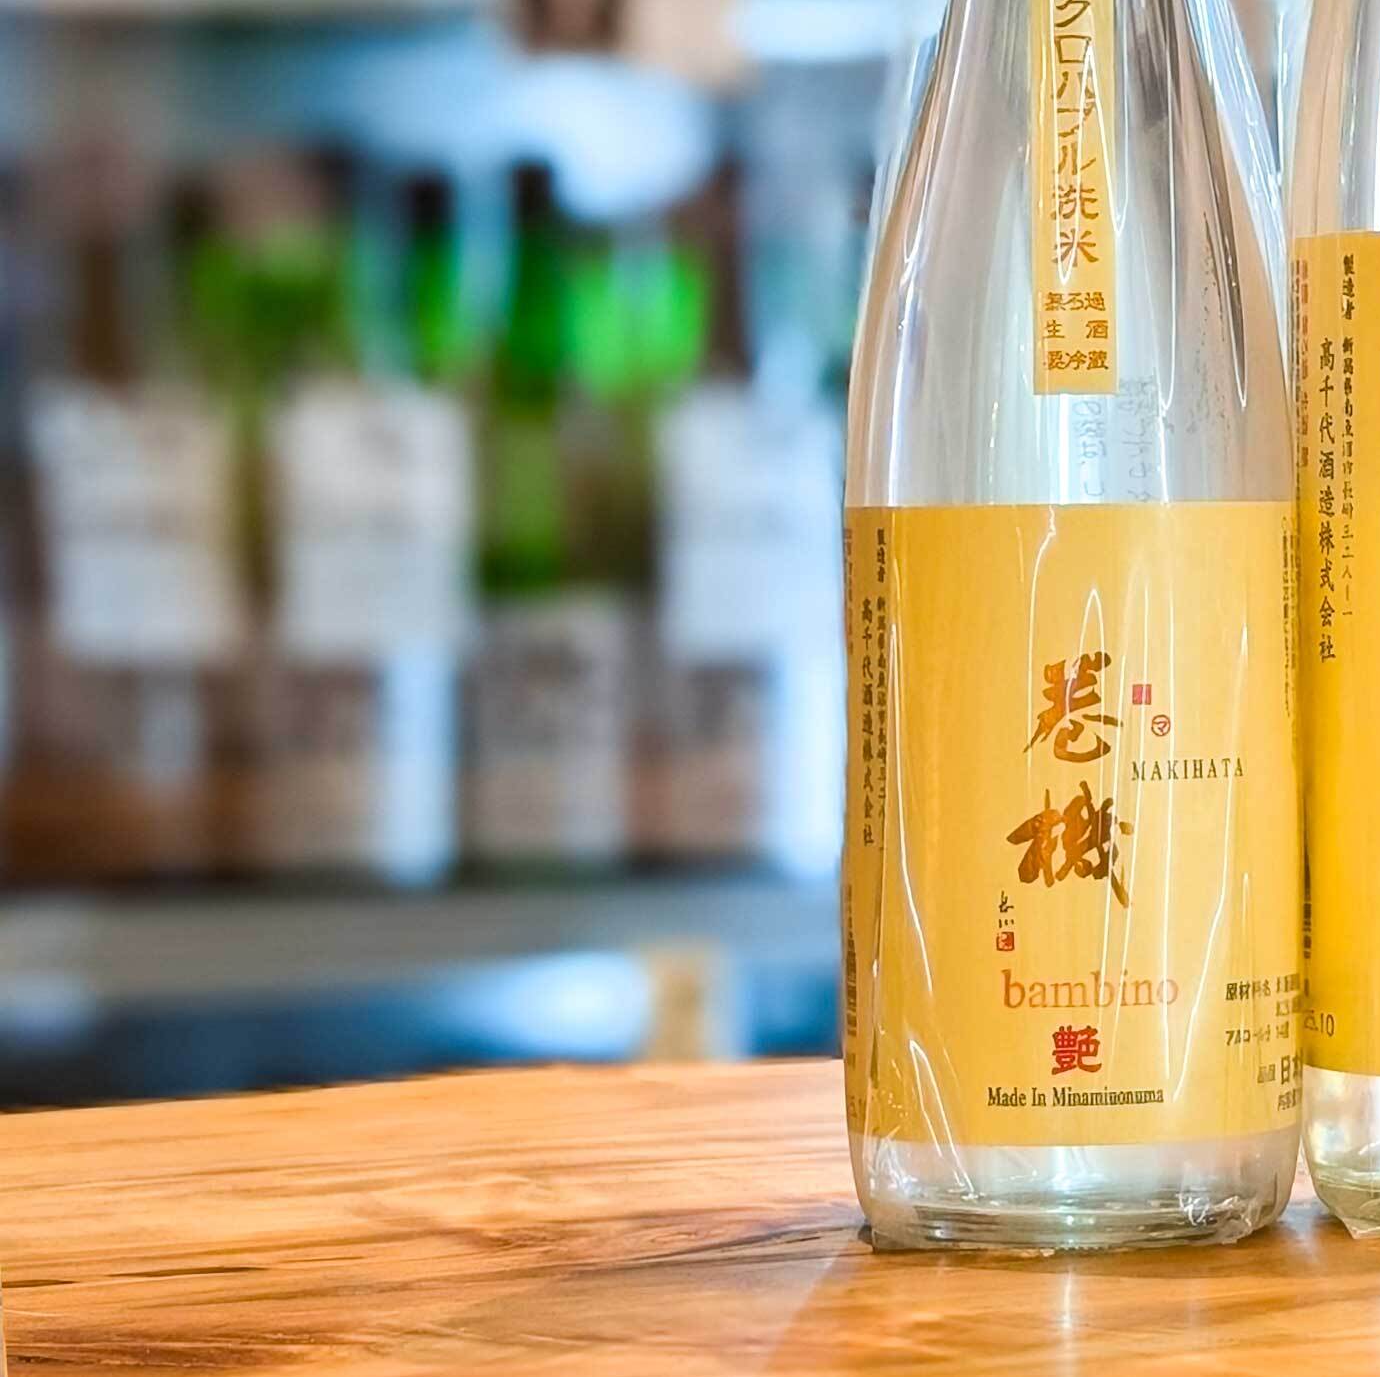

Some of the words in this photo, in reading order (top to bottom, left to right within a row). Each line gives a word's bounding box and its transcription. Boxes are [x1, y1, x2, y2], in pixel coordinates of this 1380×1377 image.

[1045, 291, 1106, 311] 無ろ過
[1046, 350, 1108, 371] 要冷蔵
[1317, 337, 1337, 664] 高千代酒造株式会社
[1131, 757, 1245, 781] MAKIHATA
[1001, 968, 1179, 1009] bambino
[987, 1086, 1027, 1108] Made
[1032, 1087, 1047, 1107] In
[1052, 1085, 1165, 1107] Minamiuonuma
